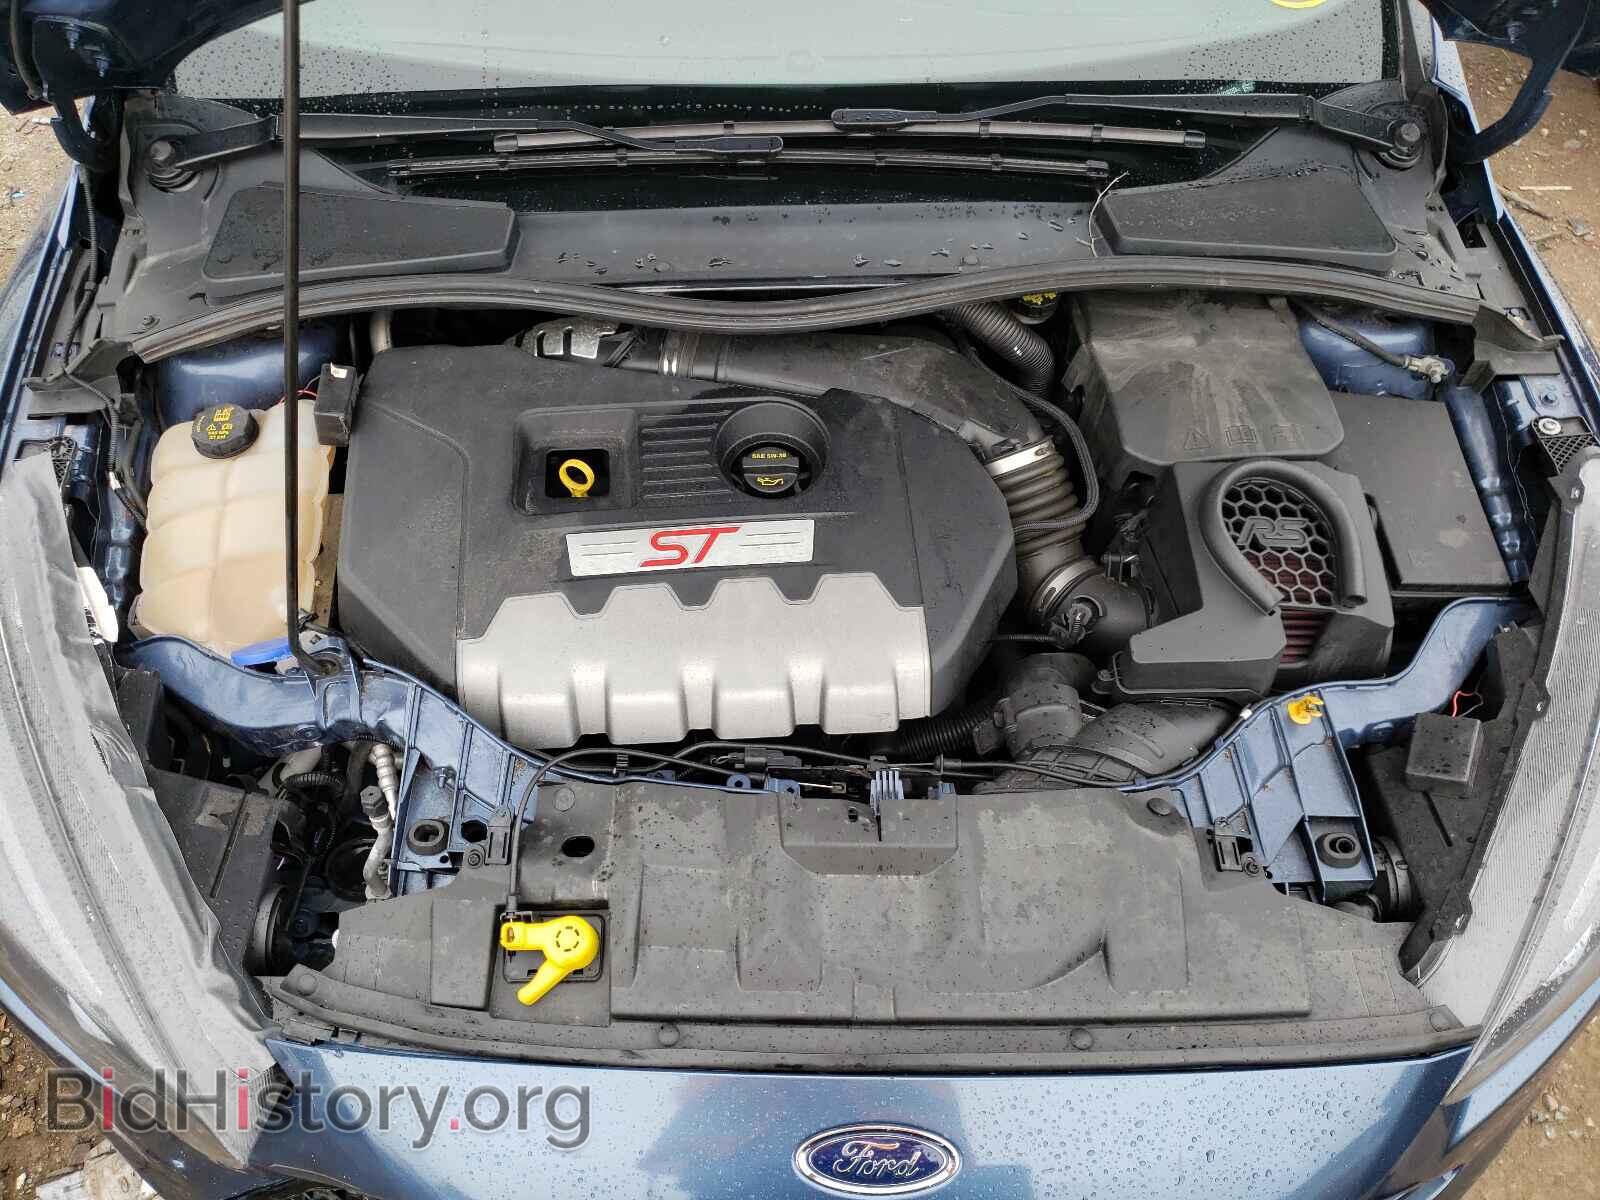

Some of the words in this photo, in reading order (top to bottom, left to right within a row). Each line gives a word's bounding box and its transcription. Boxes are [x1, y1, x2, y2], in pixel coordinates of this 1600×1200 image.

[639, 526, 742, 568] ST
[1236, 516, 1308, 547] RS
[833, 1140, 920, 1177] Ford
